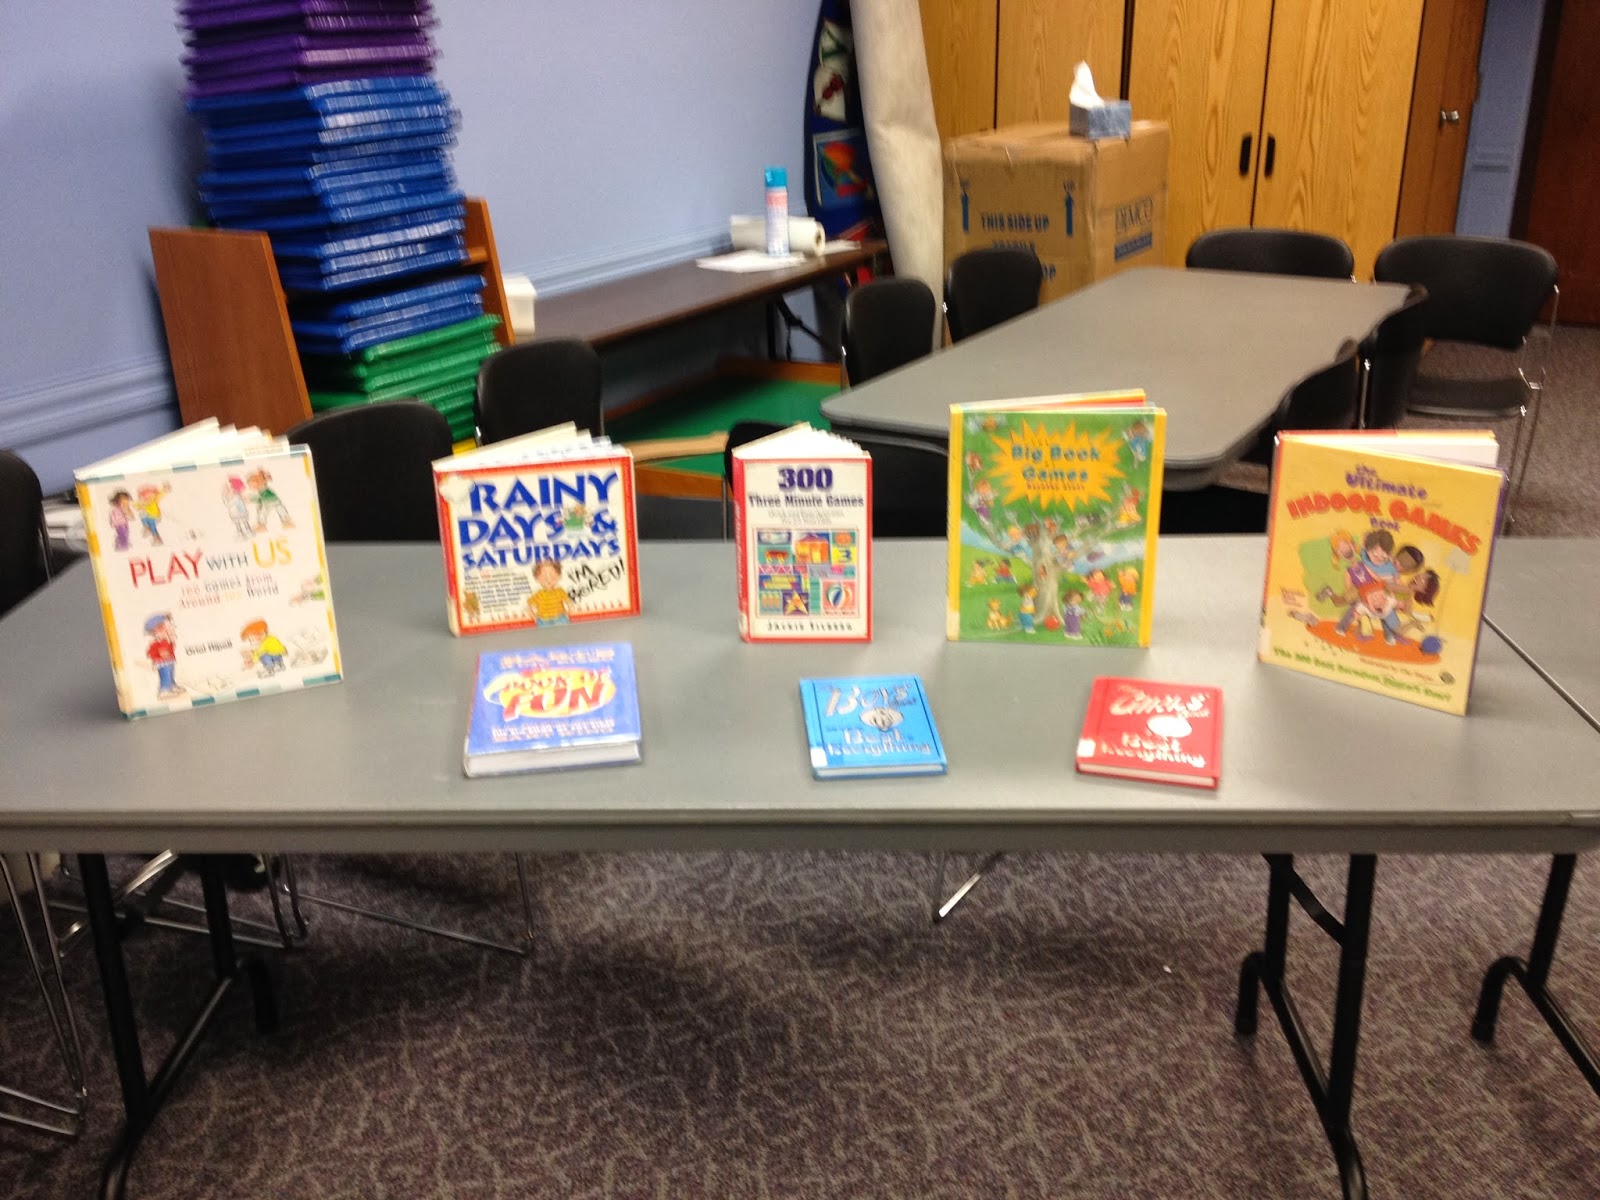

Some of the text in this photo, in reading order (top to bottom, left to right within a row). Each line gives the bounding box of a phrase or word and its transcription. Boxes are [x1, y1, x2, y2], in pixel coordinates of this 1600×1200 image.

[980, 213, 1050, 232] THIS SIDE UP
[1012, 444, 1100, 463] Big Book
[778, 467, 834, 492] 300
[1023, 466, 1089, 482] Games
[1345, 472, 1428, 500] Ultimate
[469, 470, 619, 517] RAINY
[748, 495, 865, 508] Three Minute Games
[458, 512, 564, 548] DAYS
[1286, 491, 1482, 556] INDOOR GAMES
[128, 537, 293, 589] PLAY WITH US
[462, 538, 621, 568] SATURDAYS
[502, 679, 606, 722] FUN
